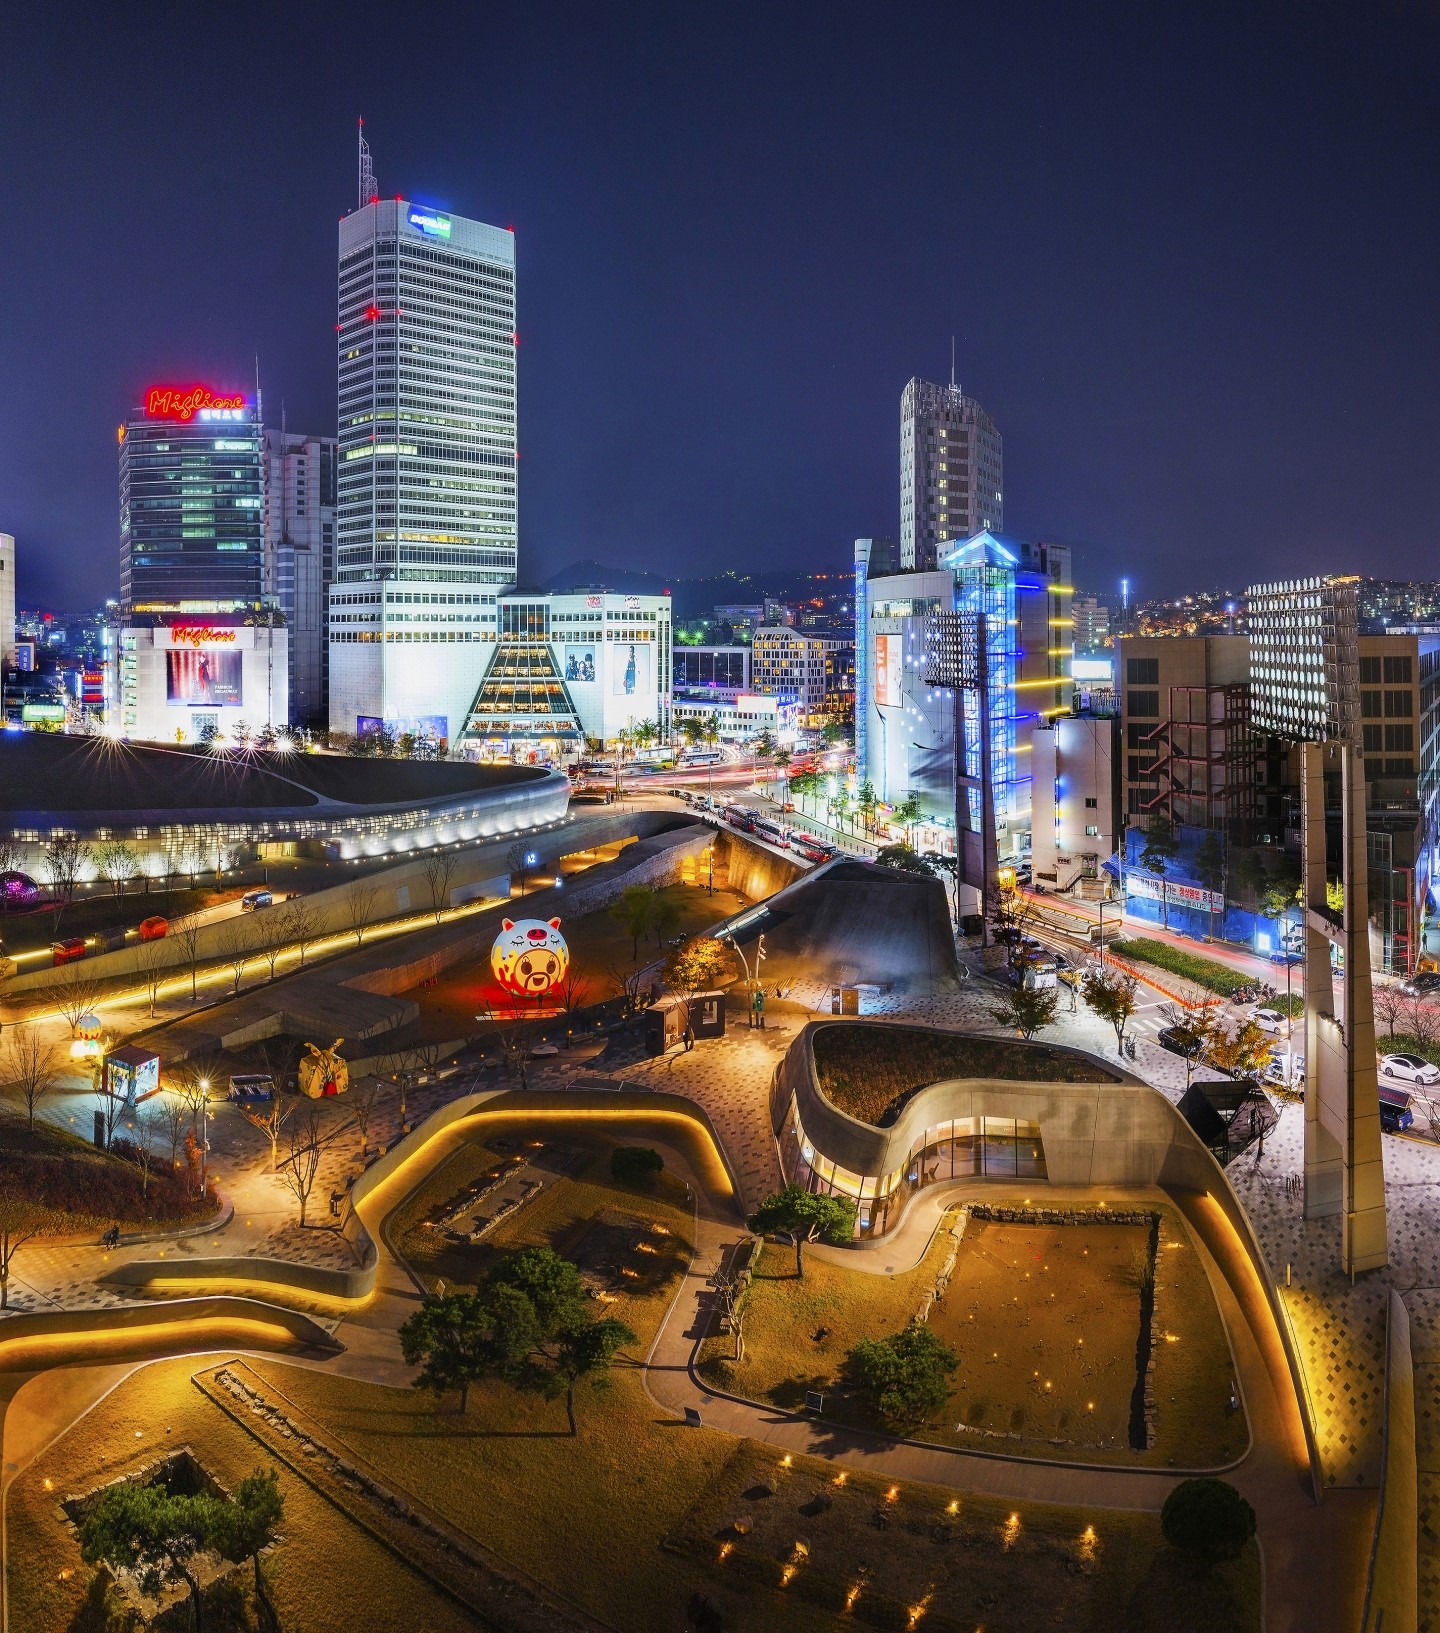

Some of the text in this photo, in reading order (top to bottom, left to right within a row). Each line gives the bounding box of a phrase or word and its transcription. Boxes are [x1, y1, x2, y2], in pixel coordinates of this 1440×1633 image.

[150, 389, 244, 419] Migliore
[172, 628, 236, 648] Migliore
[527, 853, 536, 864] A2
